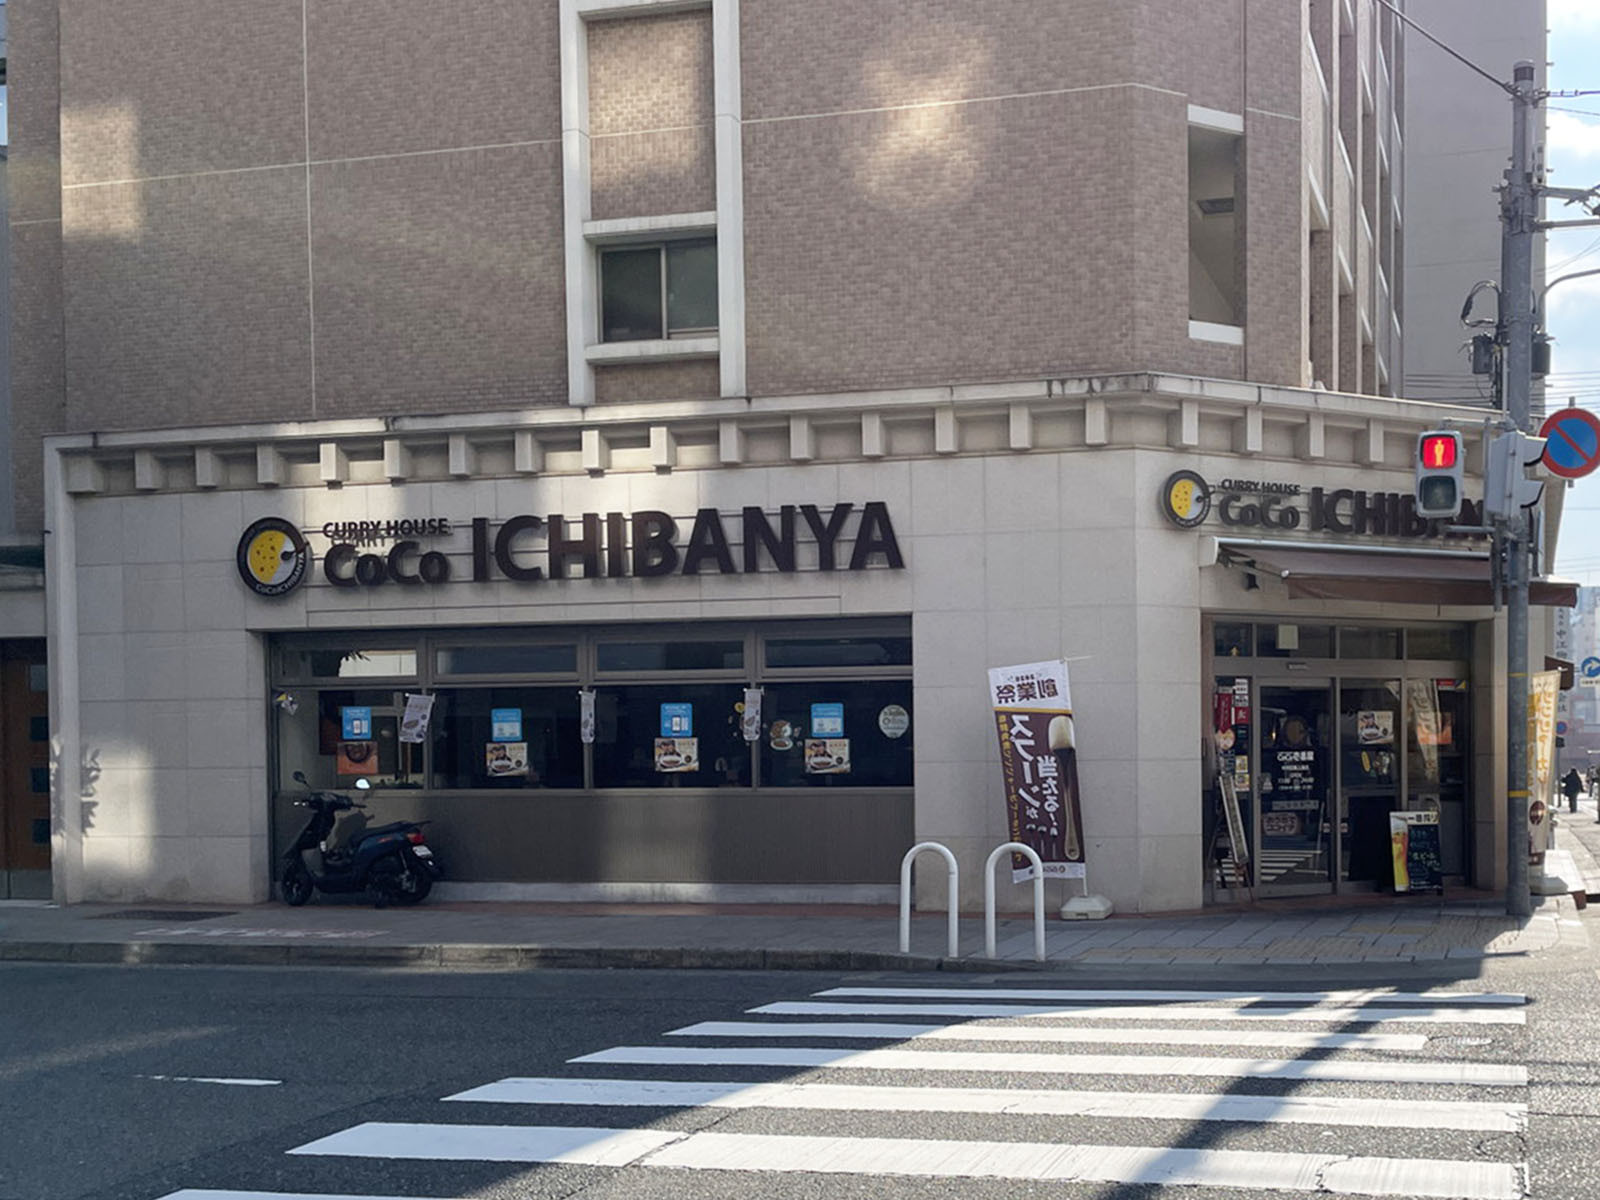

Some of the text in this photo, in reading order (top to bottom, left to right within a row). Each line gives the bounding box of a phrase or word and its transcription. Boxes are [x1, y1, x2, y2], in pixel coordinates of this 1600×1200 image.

[1221, 479, 1301, 495] CURRY HOUSE
[1219, 495, 1300, 529] CoCo
[322, 518, 449, 538] CURRY HOUSE
[323, 501, 906, 587] CoCo ICHIBANYA
